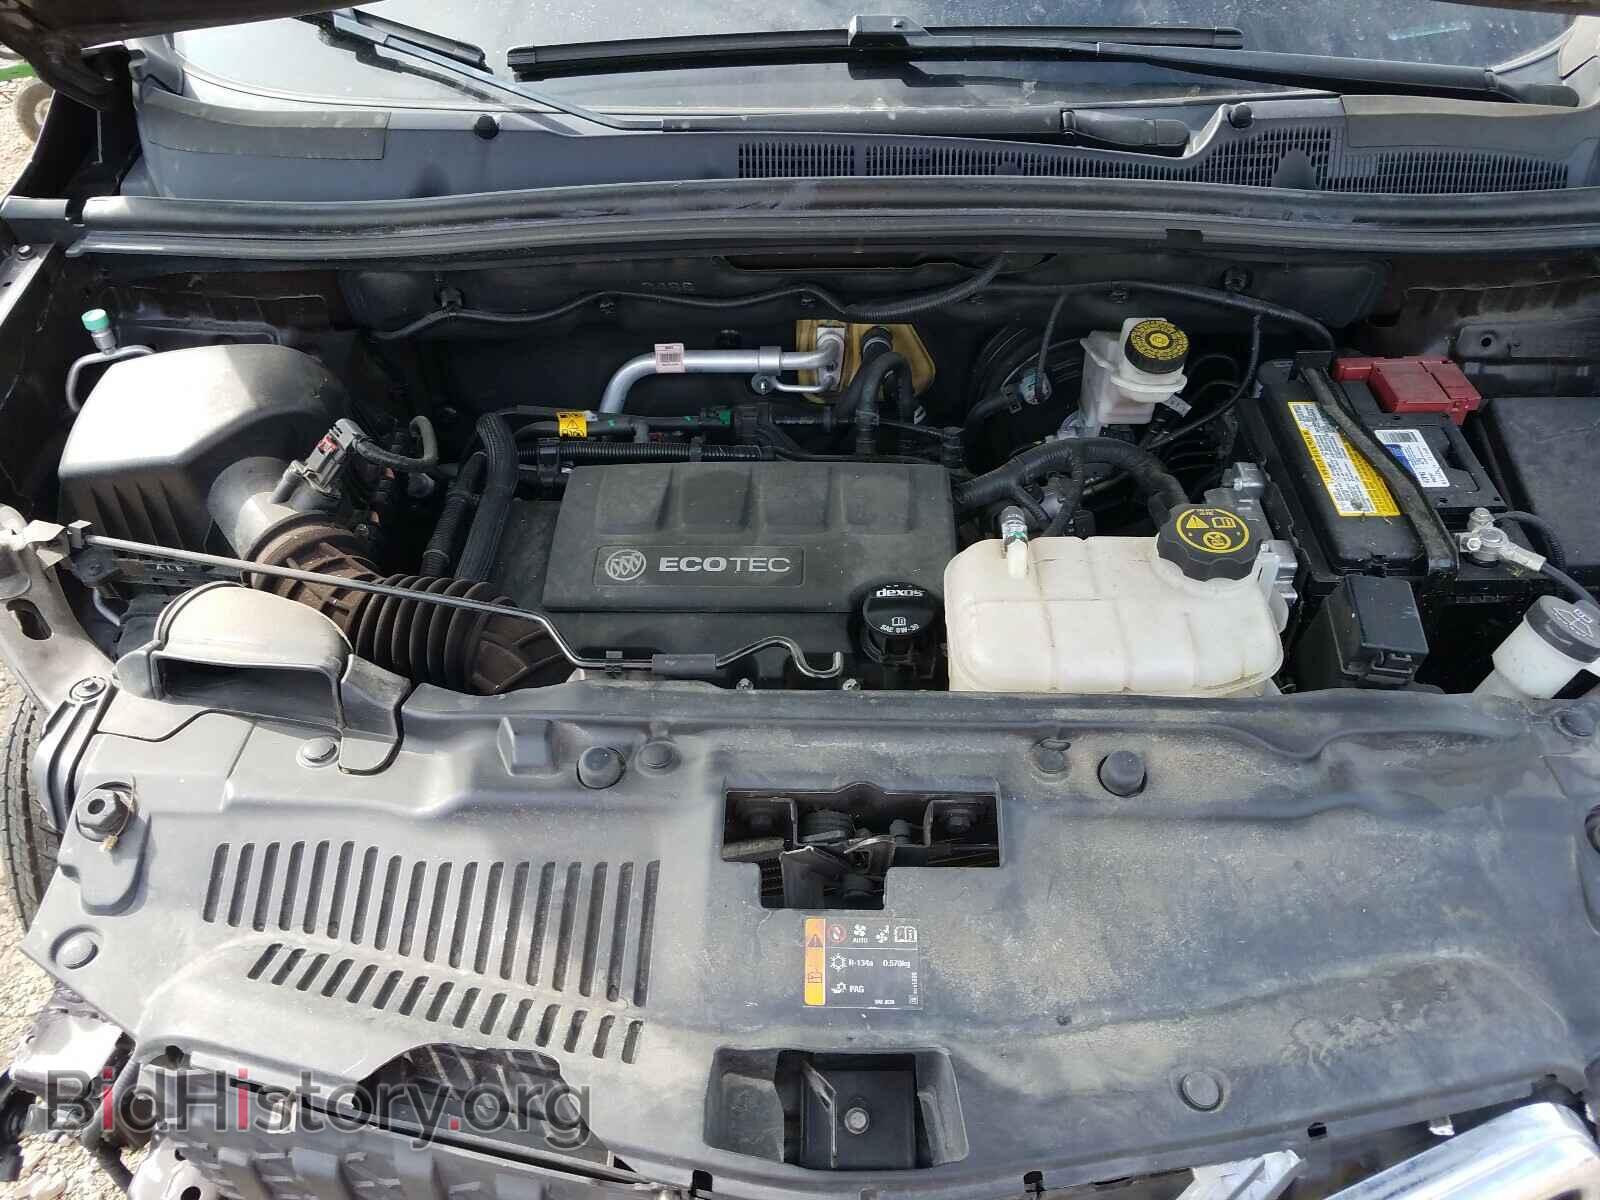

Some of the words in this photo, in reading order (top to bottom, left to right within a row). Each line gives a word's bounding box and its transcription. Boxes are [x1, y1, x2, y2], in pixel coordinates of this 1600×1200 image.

[658, 556, 792, 573] ECOTEC
[876, 588, 925, 598] dexos
[849, 985, 865, 993] PAG
